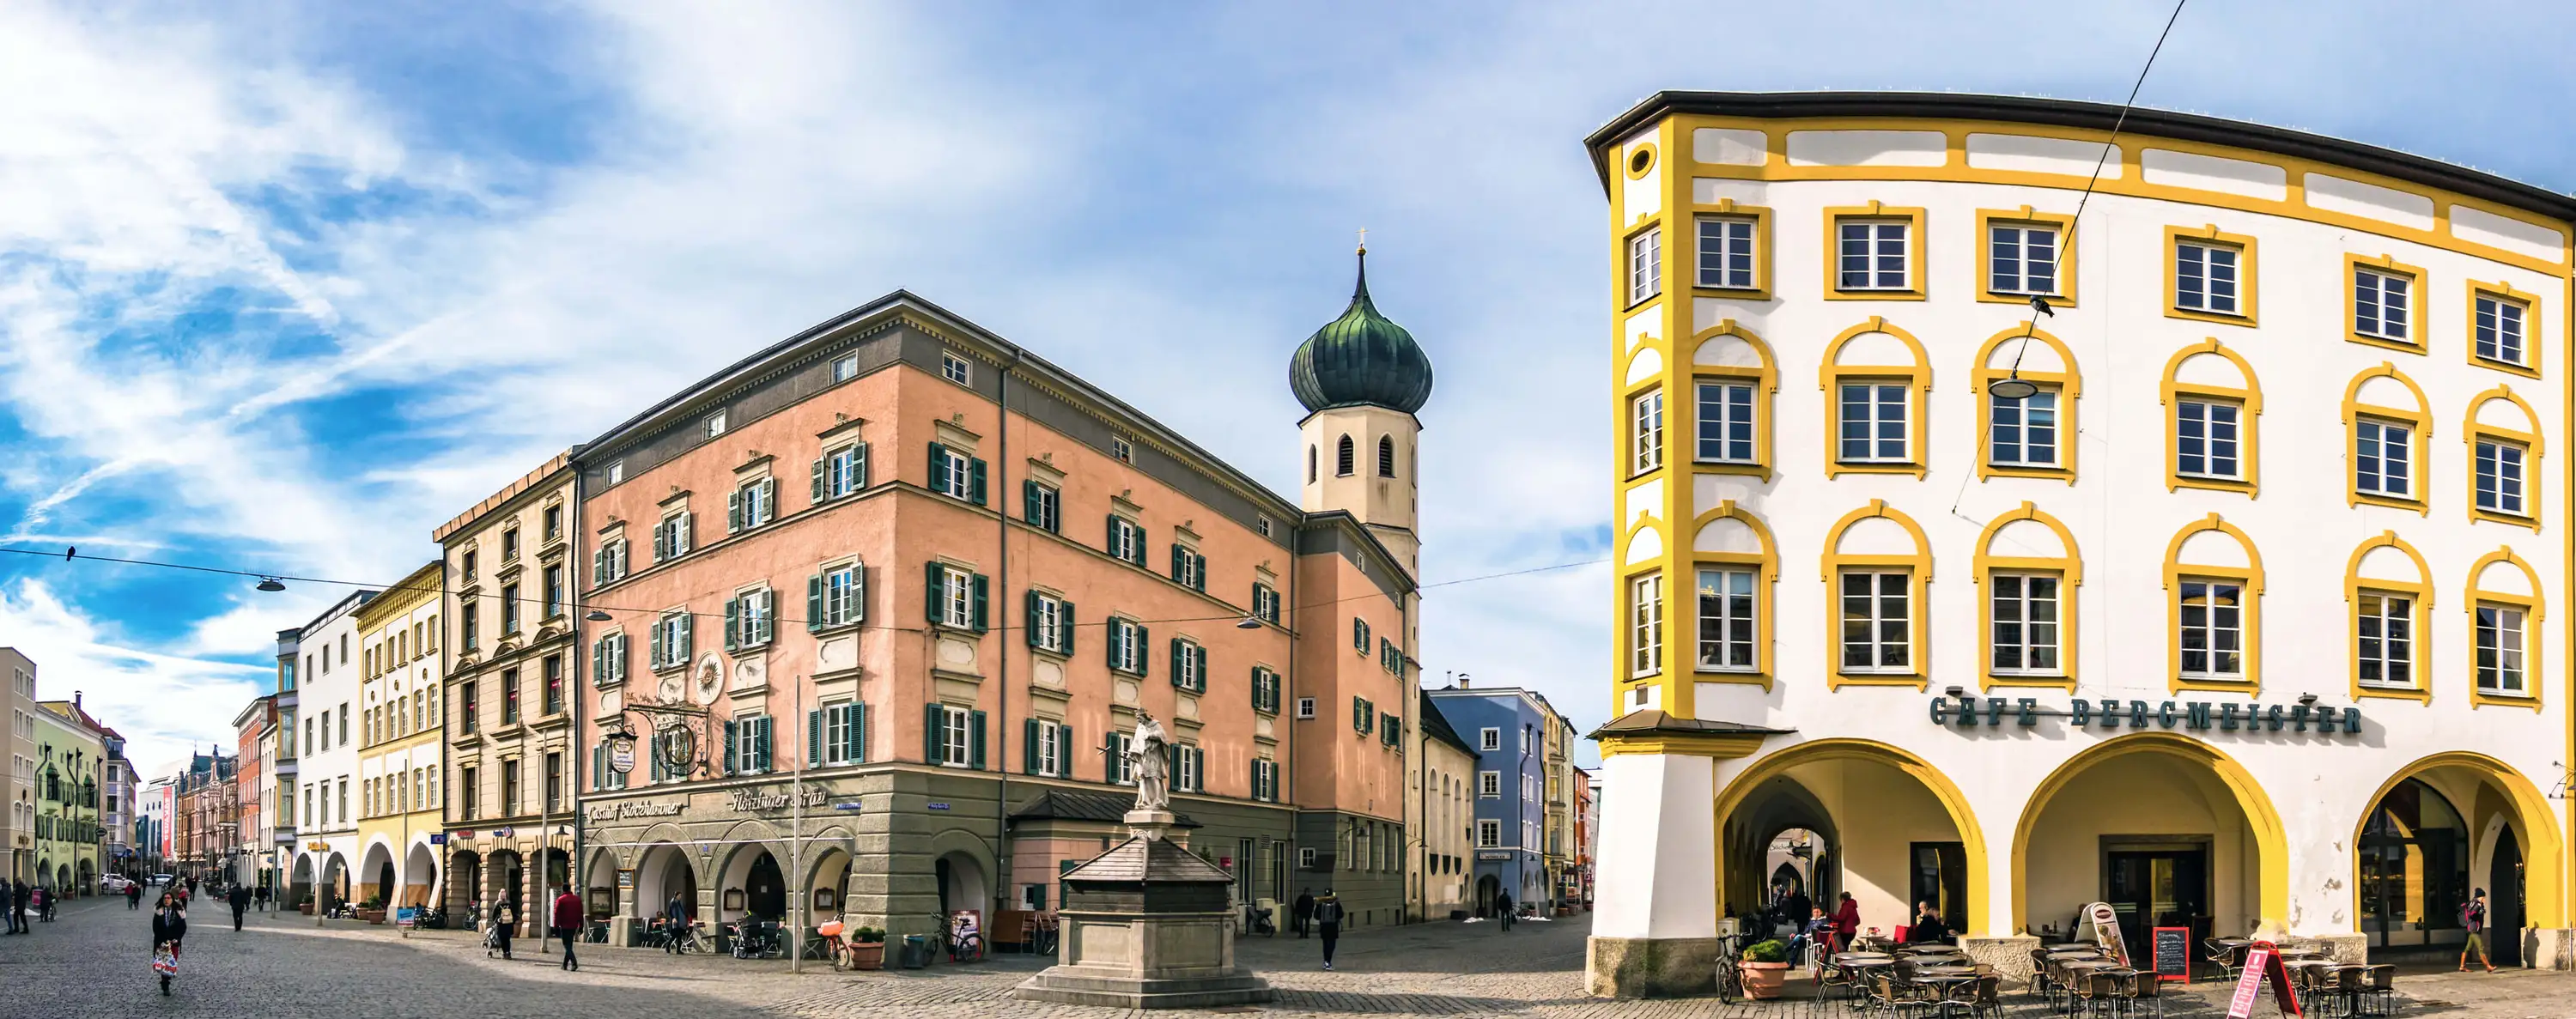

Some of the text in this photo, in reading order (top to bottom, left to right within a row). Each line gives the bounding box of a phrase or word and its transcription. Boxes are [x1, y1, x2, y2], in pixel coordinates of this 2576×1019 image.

[1930, 697, 2361, 733] CAFE BERGMEISTER
[587, 799, 683, 823] Gasthof Stockhammer
[731, 791, 788, 811] Flötzinger
